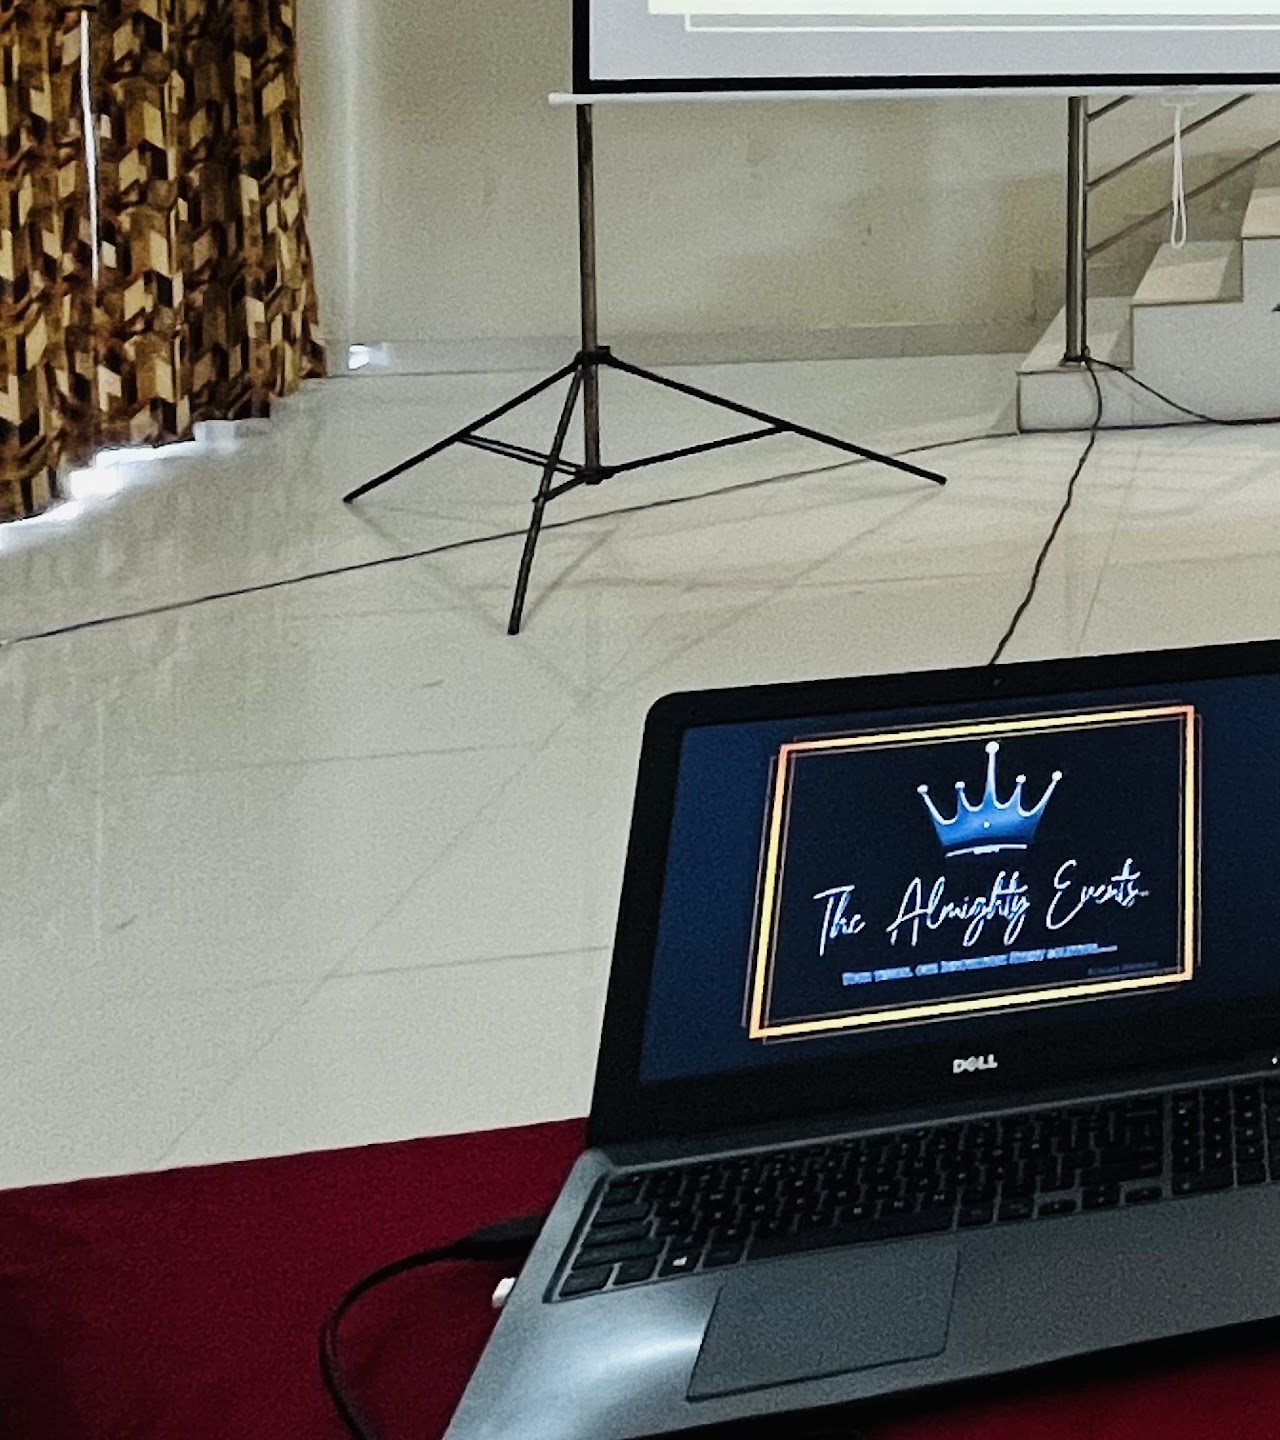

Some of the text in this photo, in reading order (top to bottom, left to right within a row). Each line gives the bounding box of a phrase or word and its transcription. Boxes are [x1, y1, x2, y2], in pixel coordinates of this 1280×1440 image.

[813, 884, 866, 958] The
[886, 871, 1031, 947] Almighty
[952, 1053, 998, 1074] DELL
